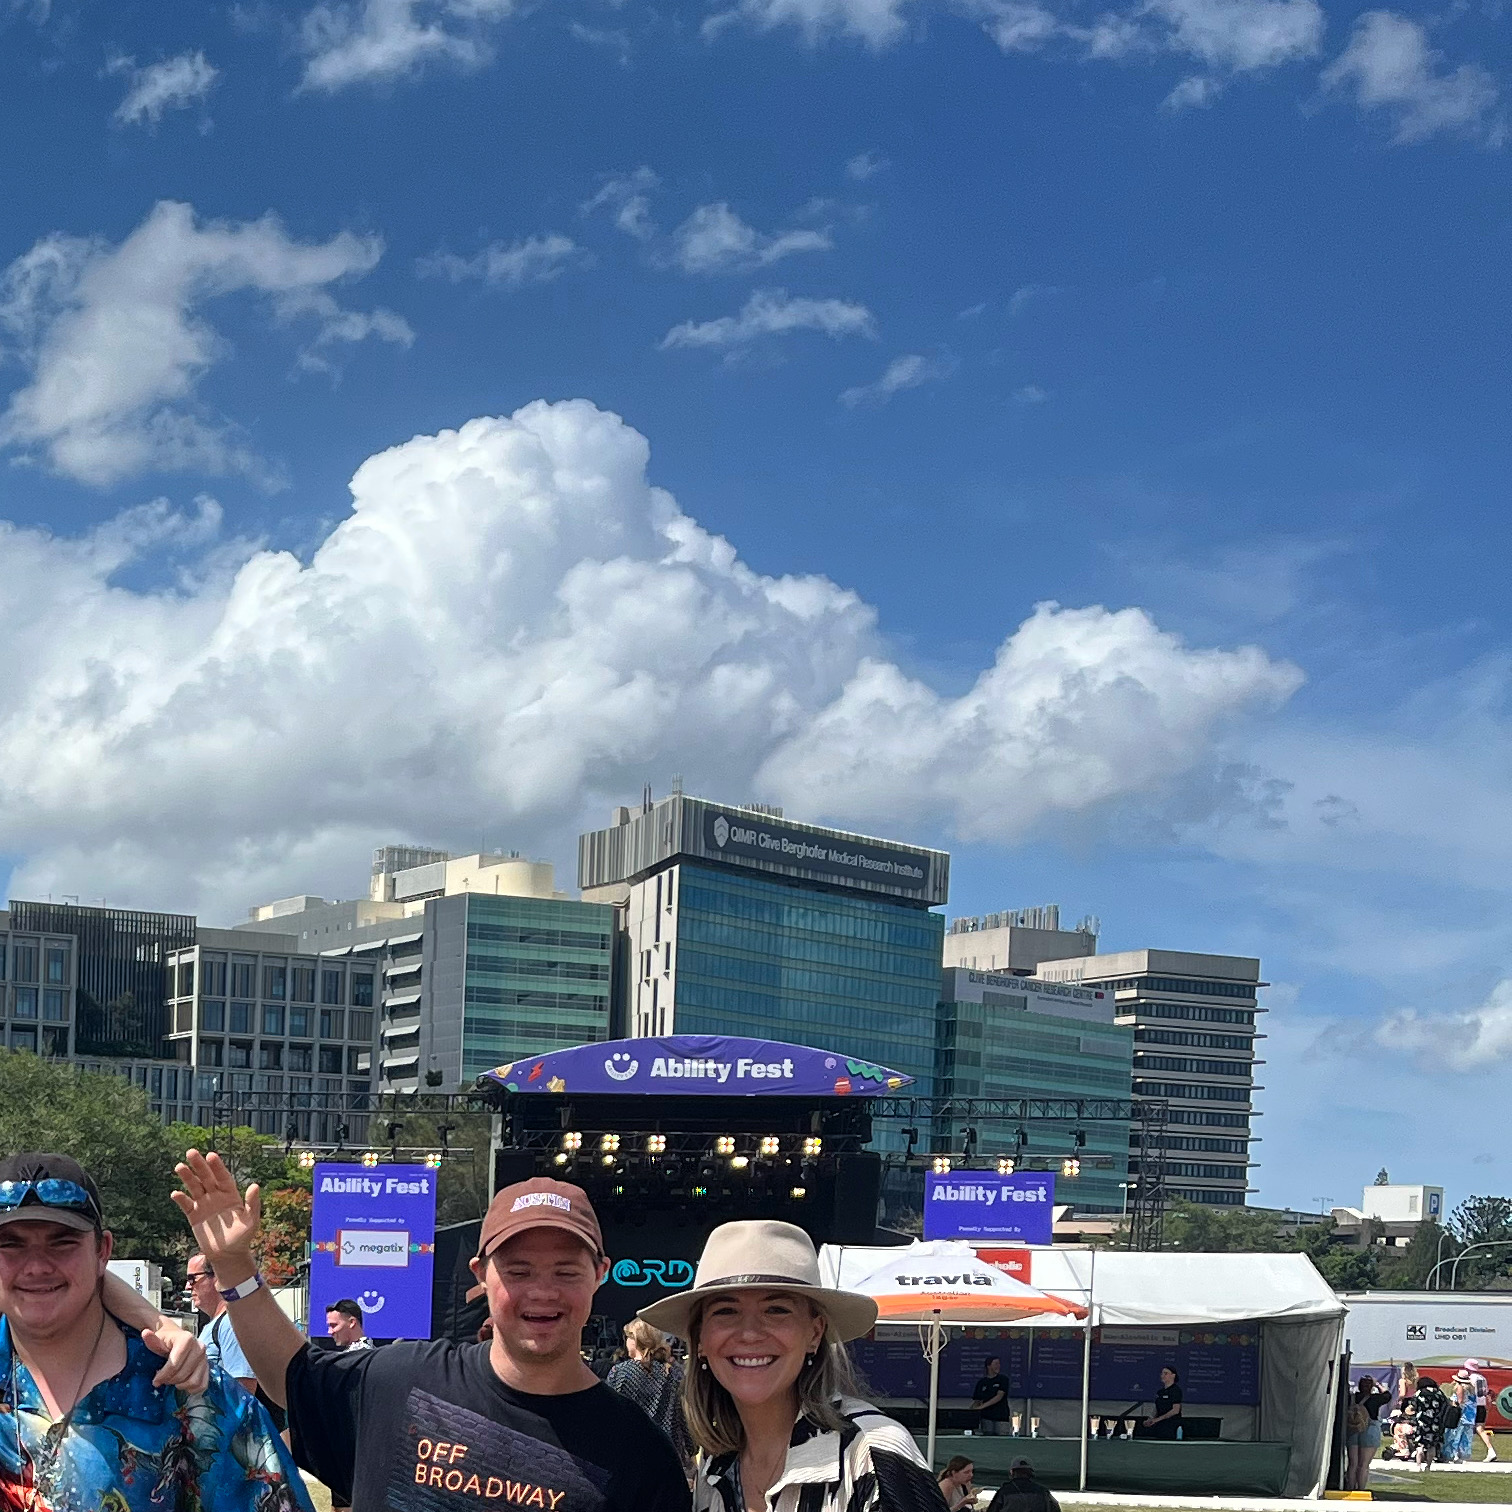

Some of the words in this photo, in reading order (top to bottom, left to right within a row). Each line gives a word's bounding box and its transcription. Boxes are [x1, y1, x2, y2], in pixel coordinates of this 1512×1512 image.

[731, 827, 757, 845] QIMR
[758, 833, 781, 850] Clive
[782, 838, 827, 859] Berghofer
[828, 849, 858, 866] Medical
[858, 855, 893, 873] Research
[894, 862, 923, 879] Institute
[650, 1057, 732, 1083] Ability
[737, 1058, 794, 1078] Fest
[320, 1178, 382, 1197] Ability
[386, 1178, 429, 1194] Fest
[932, 1185, 997, 1205] Ability
[1001, 1186, 1047, 1202] Fest
[510, 1192, 571, 1212] AUSTIN
[359, 1243, 404, 1254] megatix
[895, 1273, 993, 1286] travla
[1408, 1326, 1426, 1335] 4K
[417, 1438, 468, 1464] OFF
[414, 1463, 565, 1510] BROADWAY
